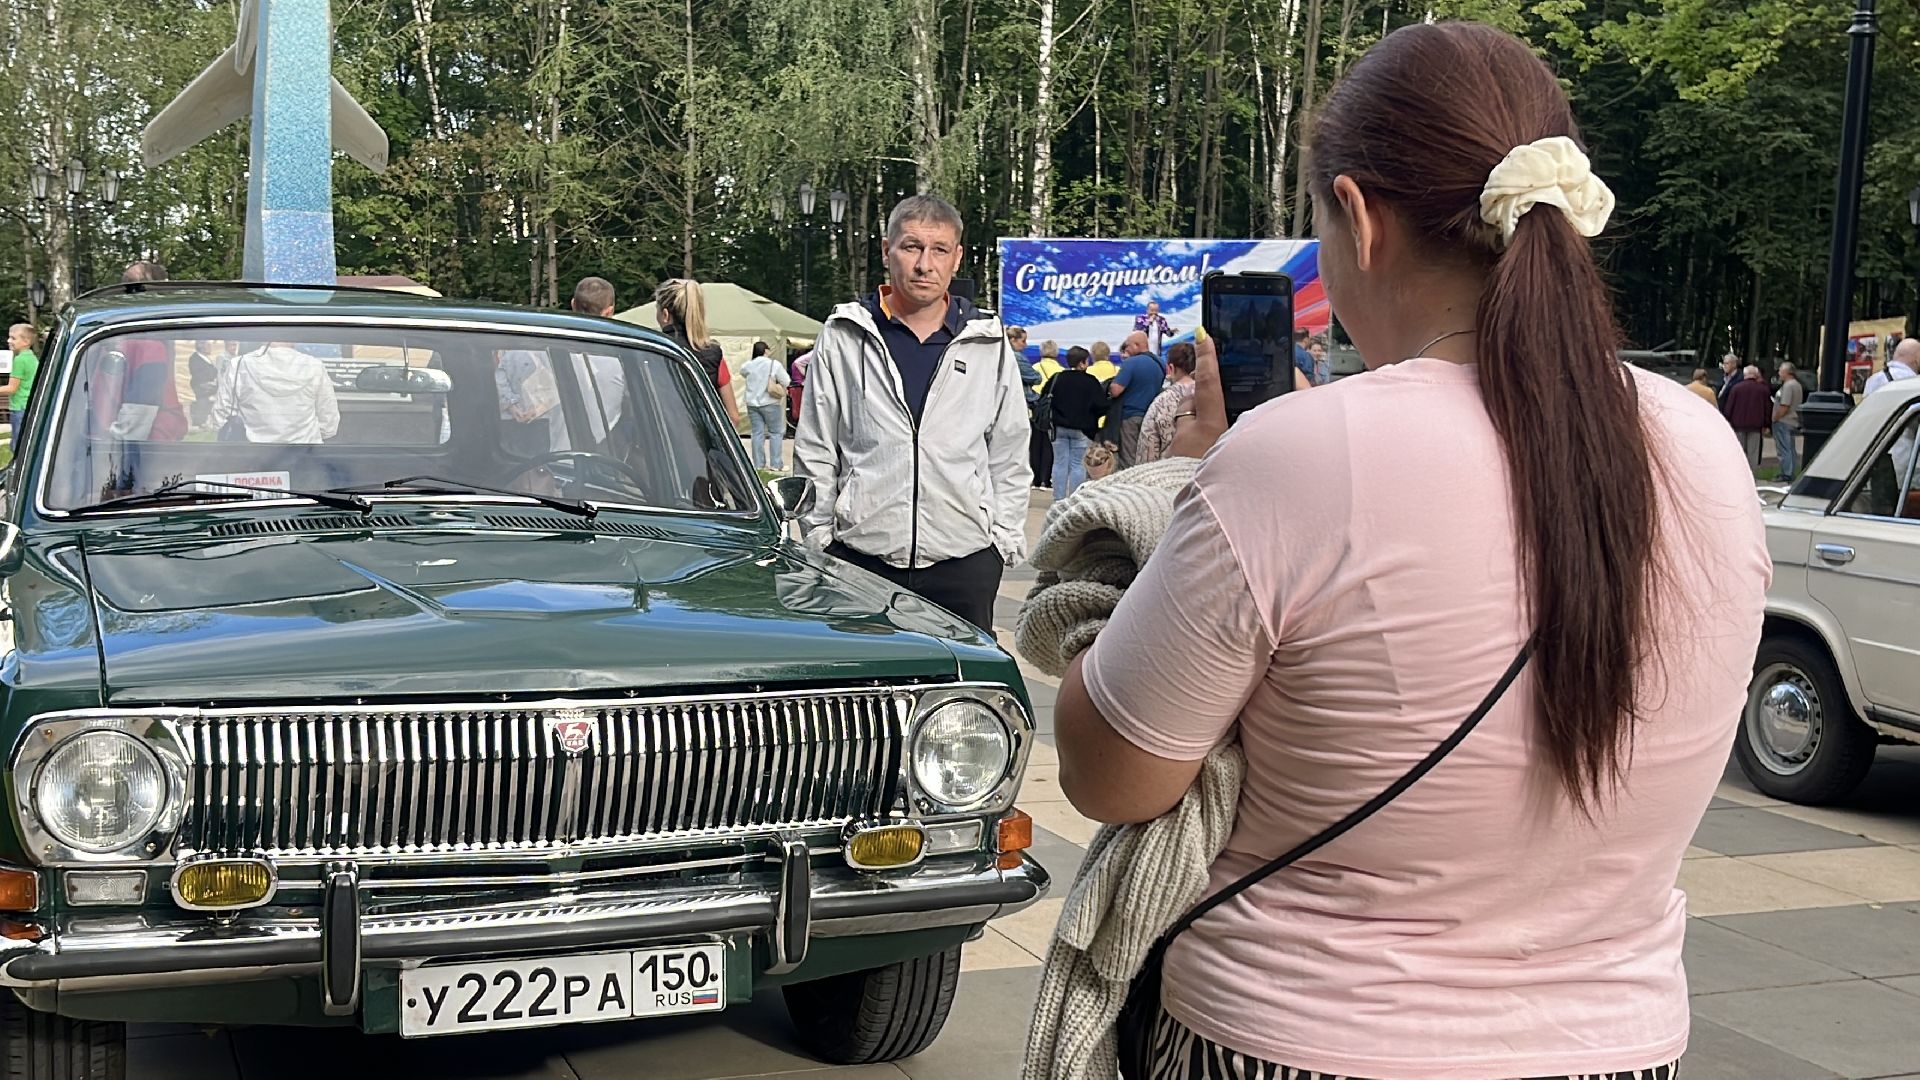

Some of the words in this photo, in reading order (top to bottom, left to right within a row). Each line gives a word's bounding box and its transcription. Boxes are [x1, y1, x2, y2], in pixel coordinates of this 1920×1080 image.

[1016, 263, 1035, 293] С
[1042, 253, 1210, 298] праздником!
[639, 951, 711, 992] 150
[656, 992, 691, 1007] RUS
